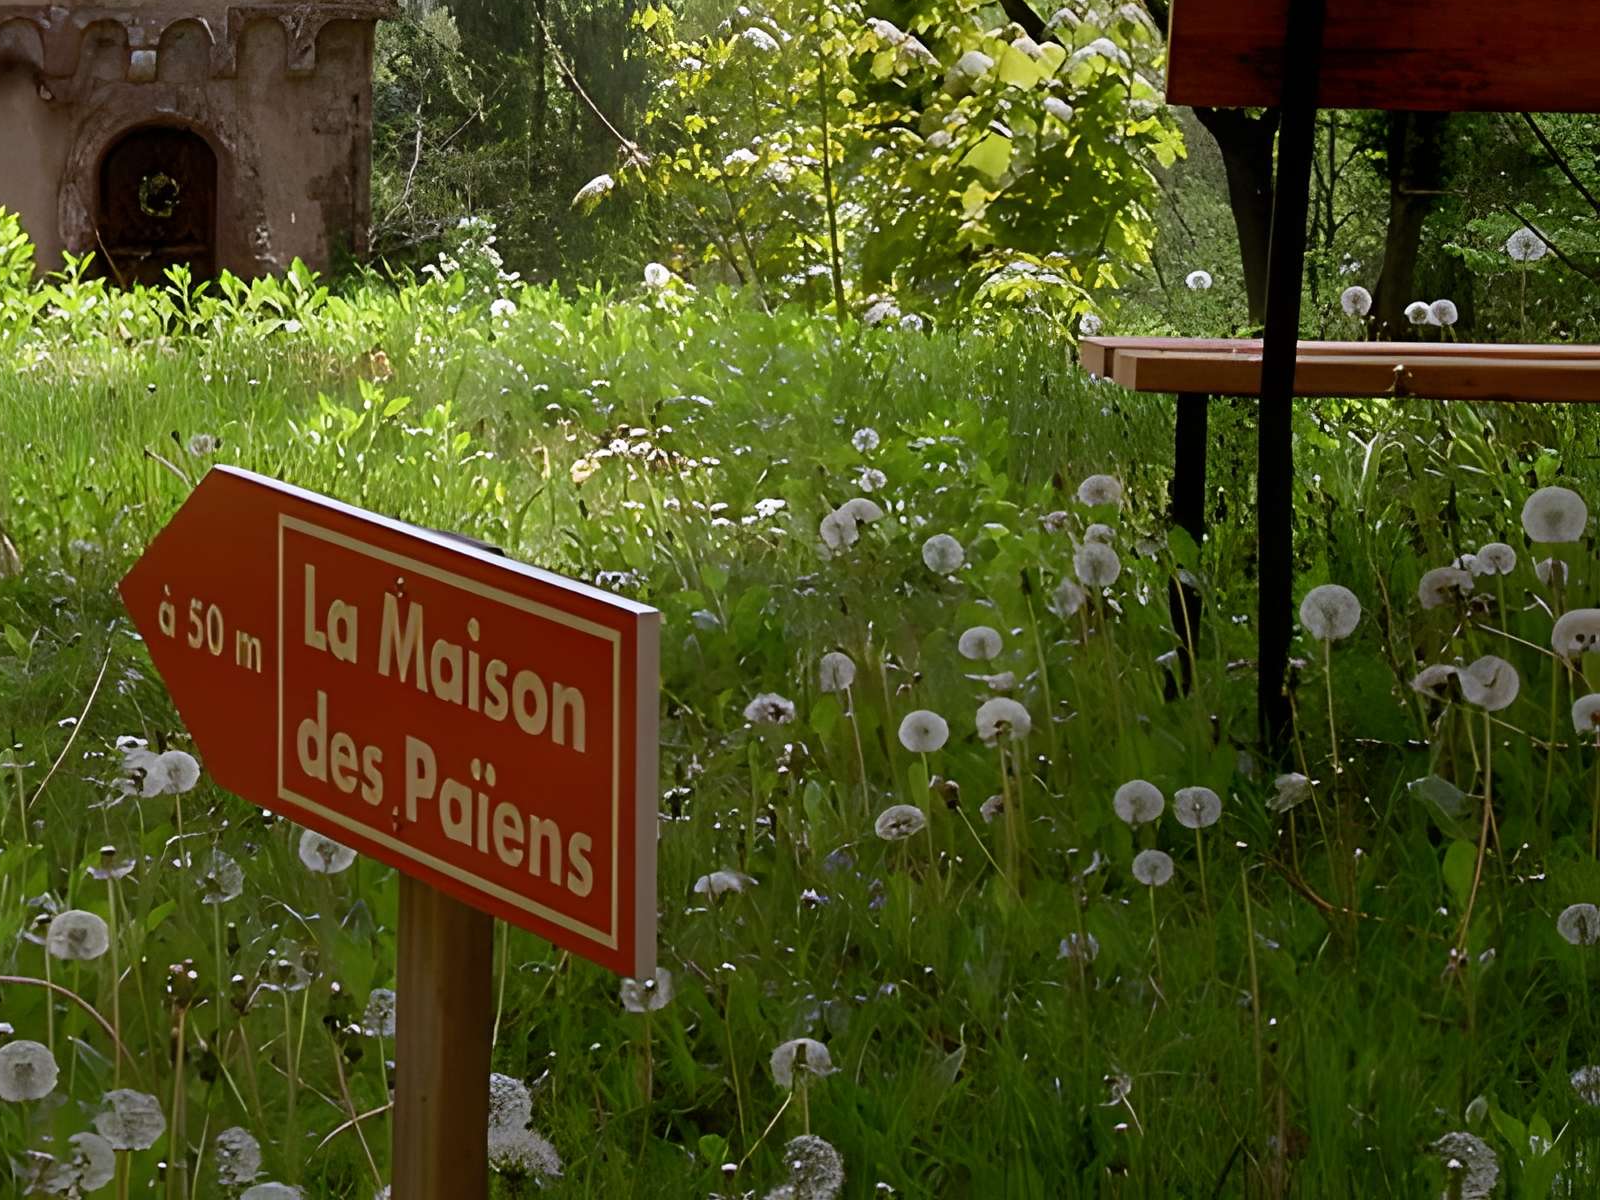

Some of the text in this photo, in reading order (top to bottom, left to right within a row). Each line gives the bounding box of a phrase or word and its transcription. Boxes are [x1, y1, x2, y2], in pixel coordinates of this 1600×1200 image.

[158, 585, 263, 673] à 50 m
[304, 563, 587, 754] La Maison
[296, 690, 595, 899] des Païens
